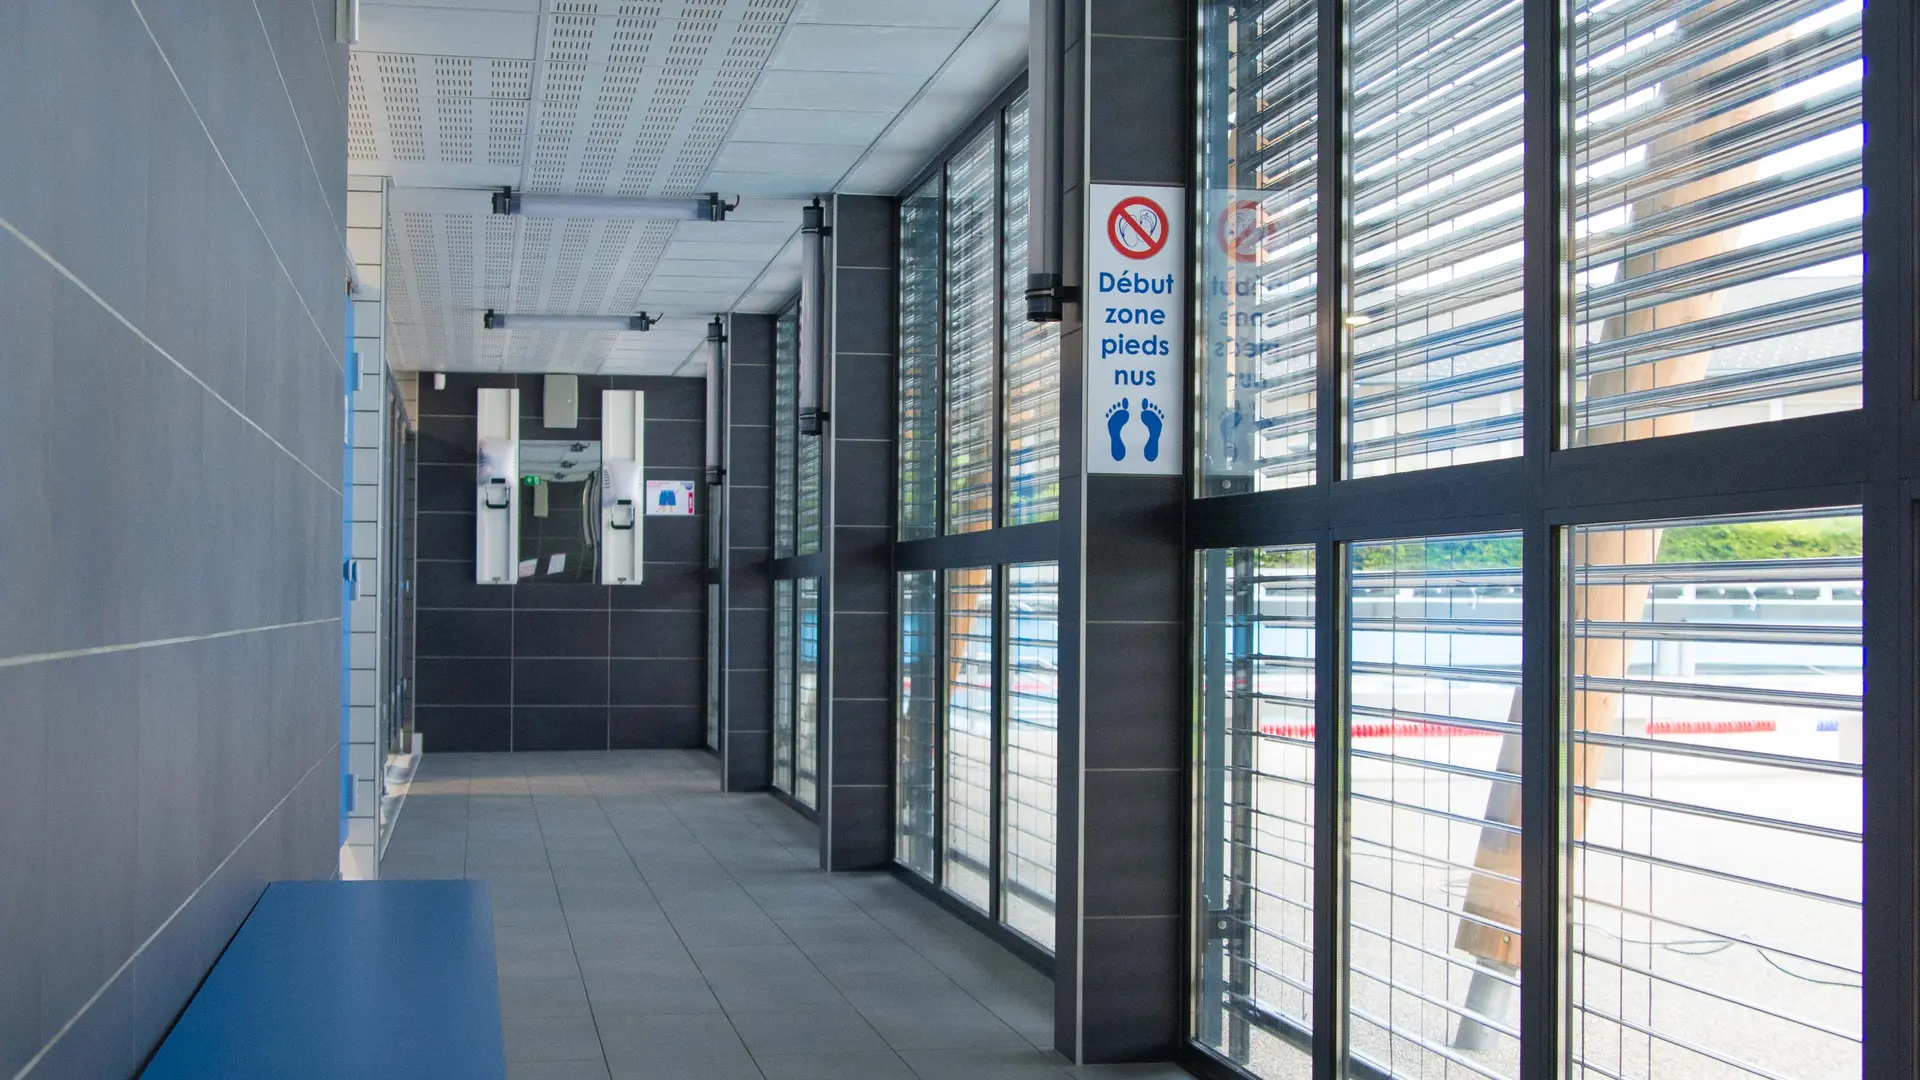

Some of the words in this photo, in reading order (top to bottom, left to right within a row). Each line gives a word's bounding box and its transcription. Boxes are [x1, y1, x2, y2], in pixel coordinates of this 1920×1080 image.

[1099, 270, 1174, 295] Début
[1105, 307, 1166, 326] zone
[1101, 333, 1170, 359] pieds
[1114, 369, 1156, 387] nus
